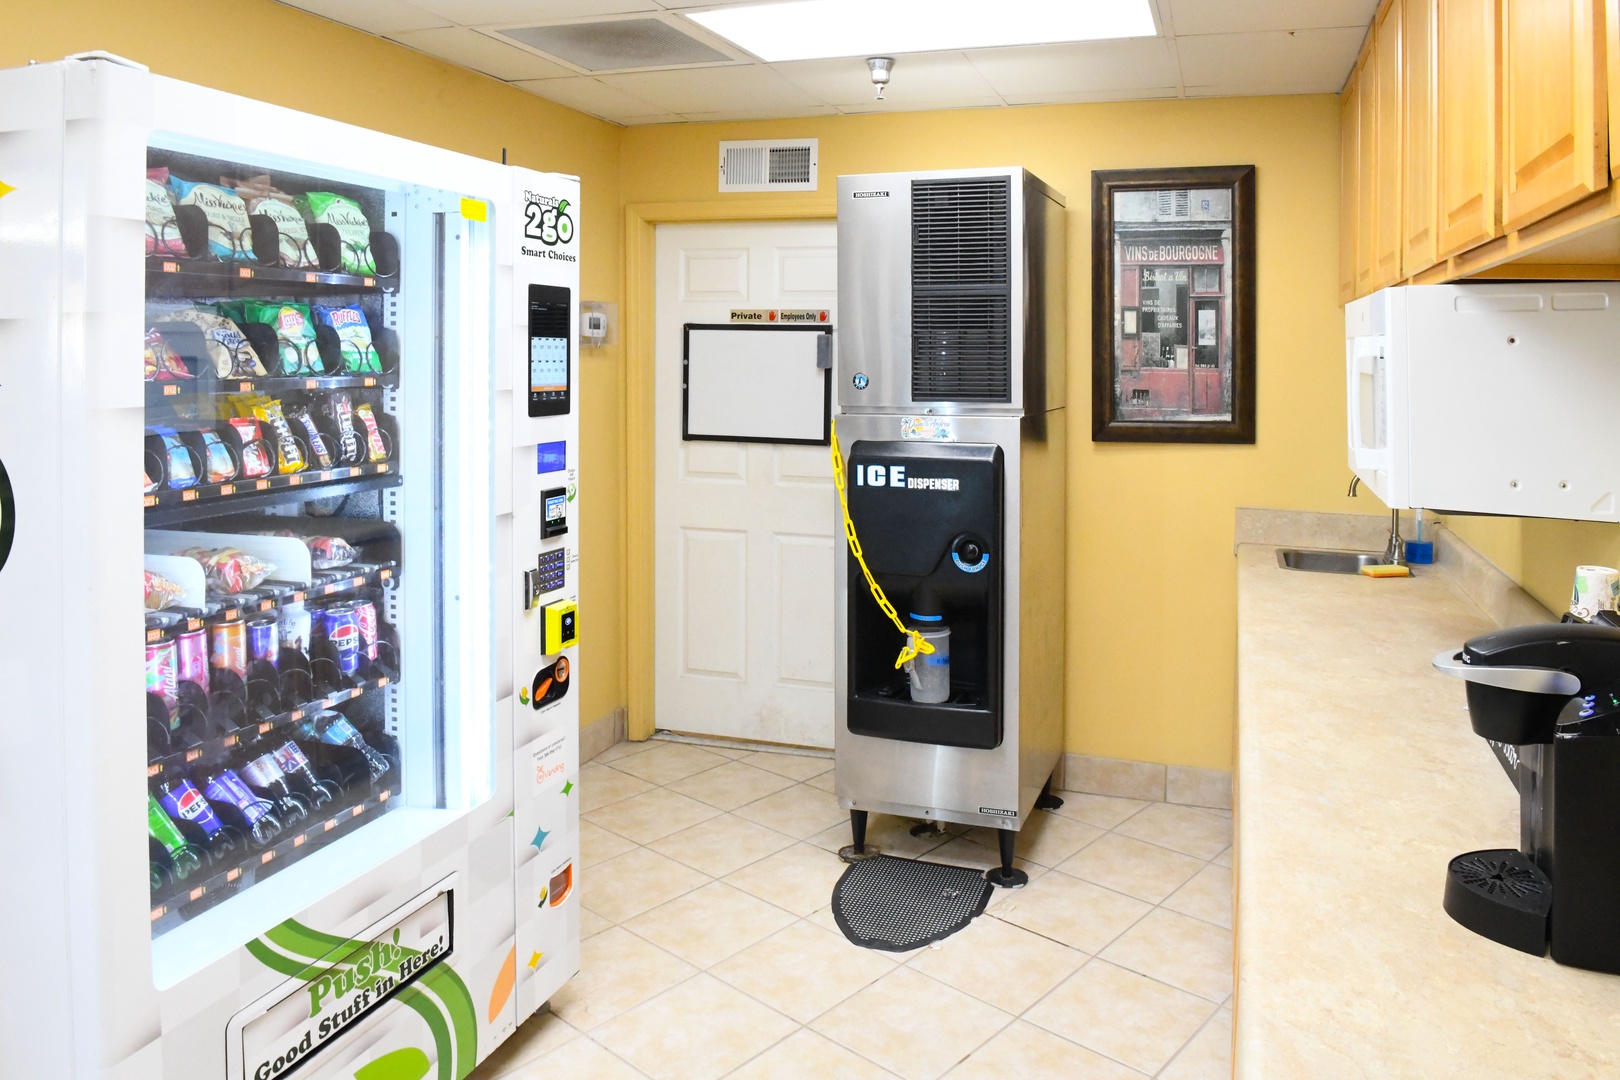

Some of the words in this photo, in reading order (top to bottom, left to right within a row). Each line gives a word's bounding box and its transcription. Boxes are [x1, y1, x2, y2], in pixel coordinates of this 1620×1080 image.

[524, 190, 560, 207] Naturals
[525, 202, 574, 246] 2go
[521, 246, 546, 258] Smart
[548, 250, 576, 262] Choices
[1125, 246, 1148, 260] VINS
[1149, 251, 1159, 260] DE
[1160, 246, 1218, 260] BOURGOGNE
[1143, 268, 1166, 282] Bistrot
[281, 313, 302, 329] Lay's
[331, 309, 362, 327] RUFFLES
[731, 312, 762, 320] Private
[780, 312, 805, 321] Employees
[805, 312, 817, 321] Only
[857, 464, 905, 488] ICE
[907, 477, 960, 491] DISPENSER
[334, 636, 358, 647] PEPS
[163, 665, 180, 702] Alani
[181, 798, 208, 819] PEPS
[981, 808, 1015, 816] HOSHIZAKI
[307, 928, 402, 1018] Push!
[254, 1033, 312, 1080] Good
[318, 991, 371, 1039] Stuff
[375, 976, 394, 1000] in
[399, 935, 444, 982] Here!
